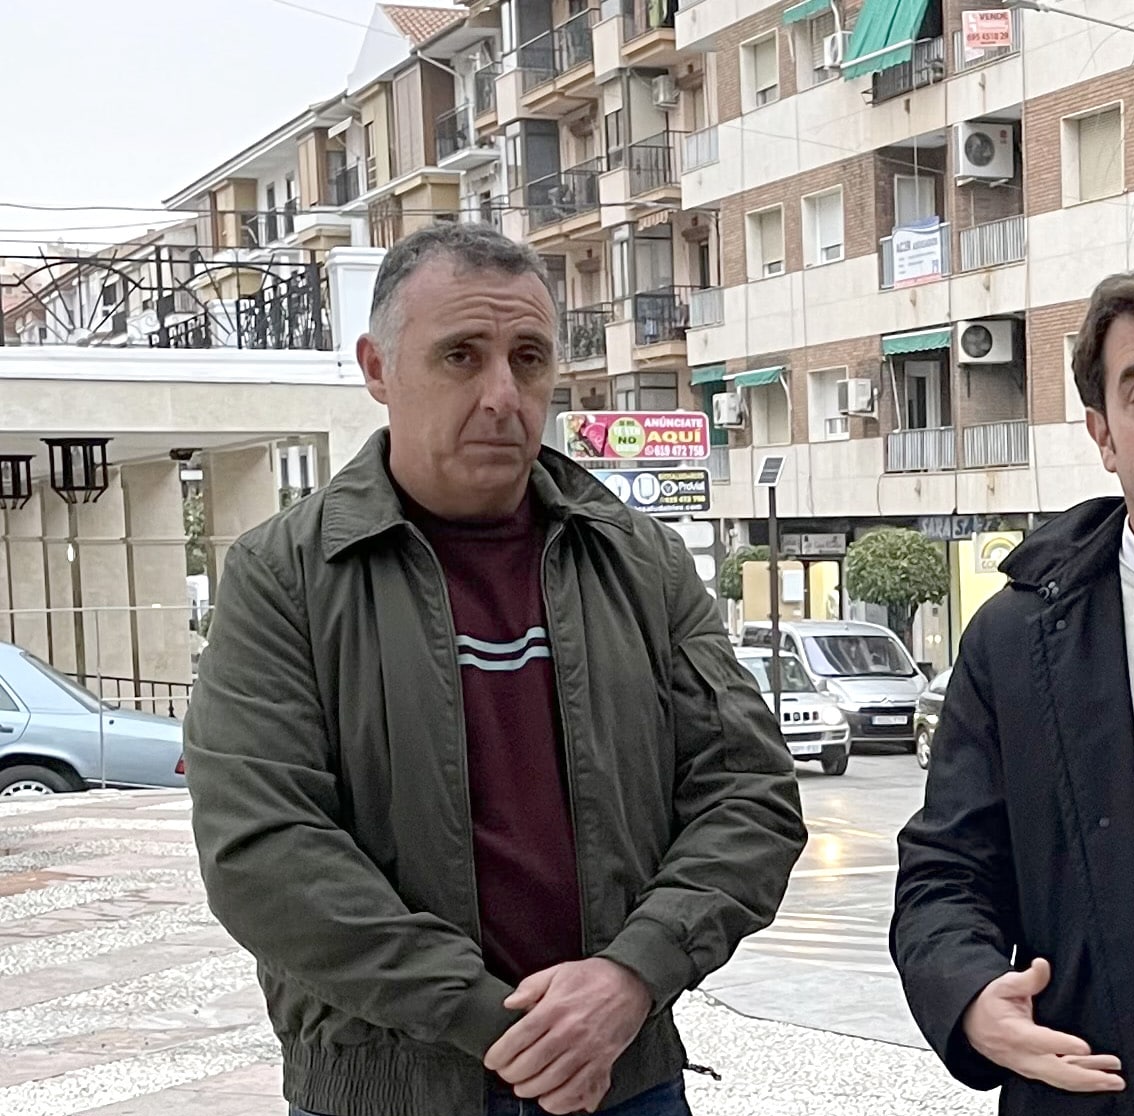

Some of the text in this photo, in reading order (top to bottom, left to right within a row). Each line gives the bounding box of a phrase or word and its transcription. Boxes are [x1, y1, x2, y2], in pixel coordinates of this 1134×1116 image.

[644, 416, 703, 428] ANÚNCIATE
[618, 436, 637, 445] NO
[647, 428, 702, 443] AQUÍ
